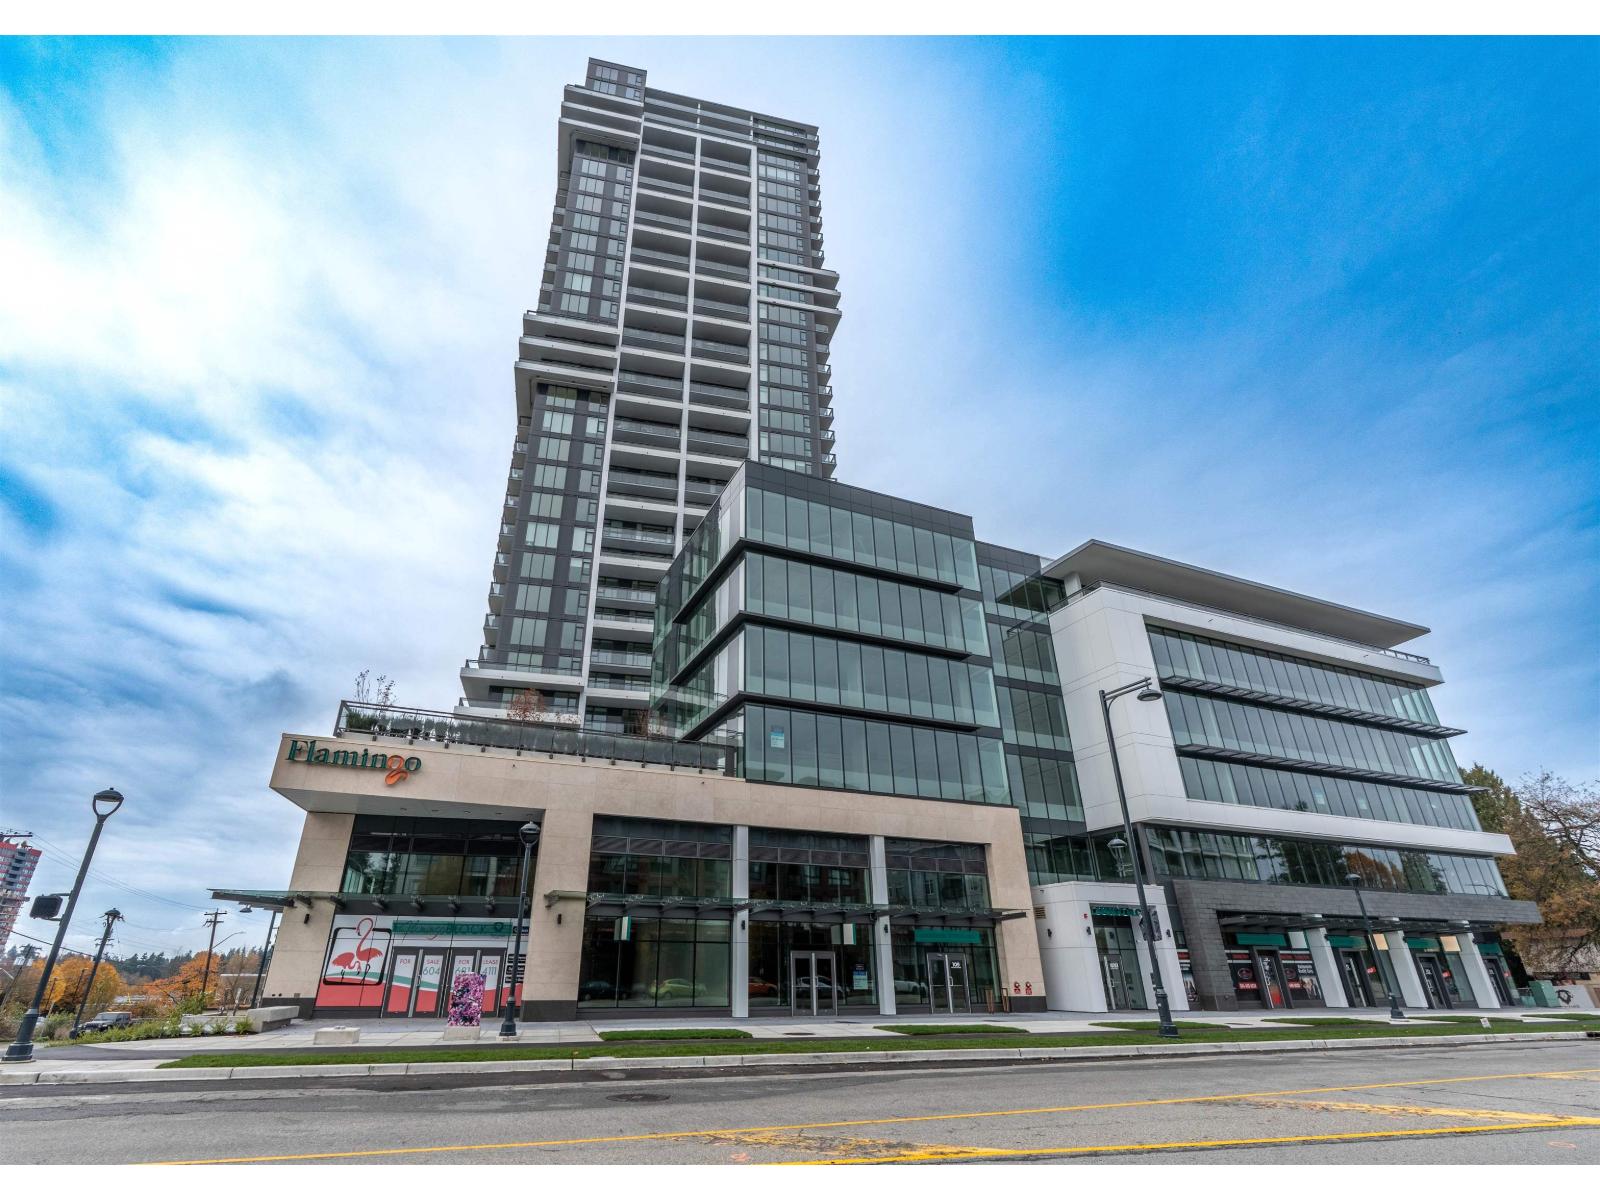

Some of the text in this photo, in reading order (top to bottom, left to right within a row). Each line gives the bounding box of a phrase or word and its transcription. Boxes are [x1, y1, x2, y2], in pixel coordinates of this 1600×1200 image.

[286, 739, 422, 786] Flamingo
[422, 966, 441, 976] 604
[481, 966, 497, 976] 4111
